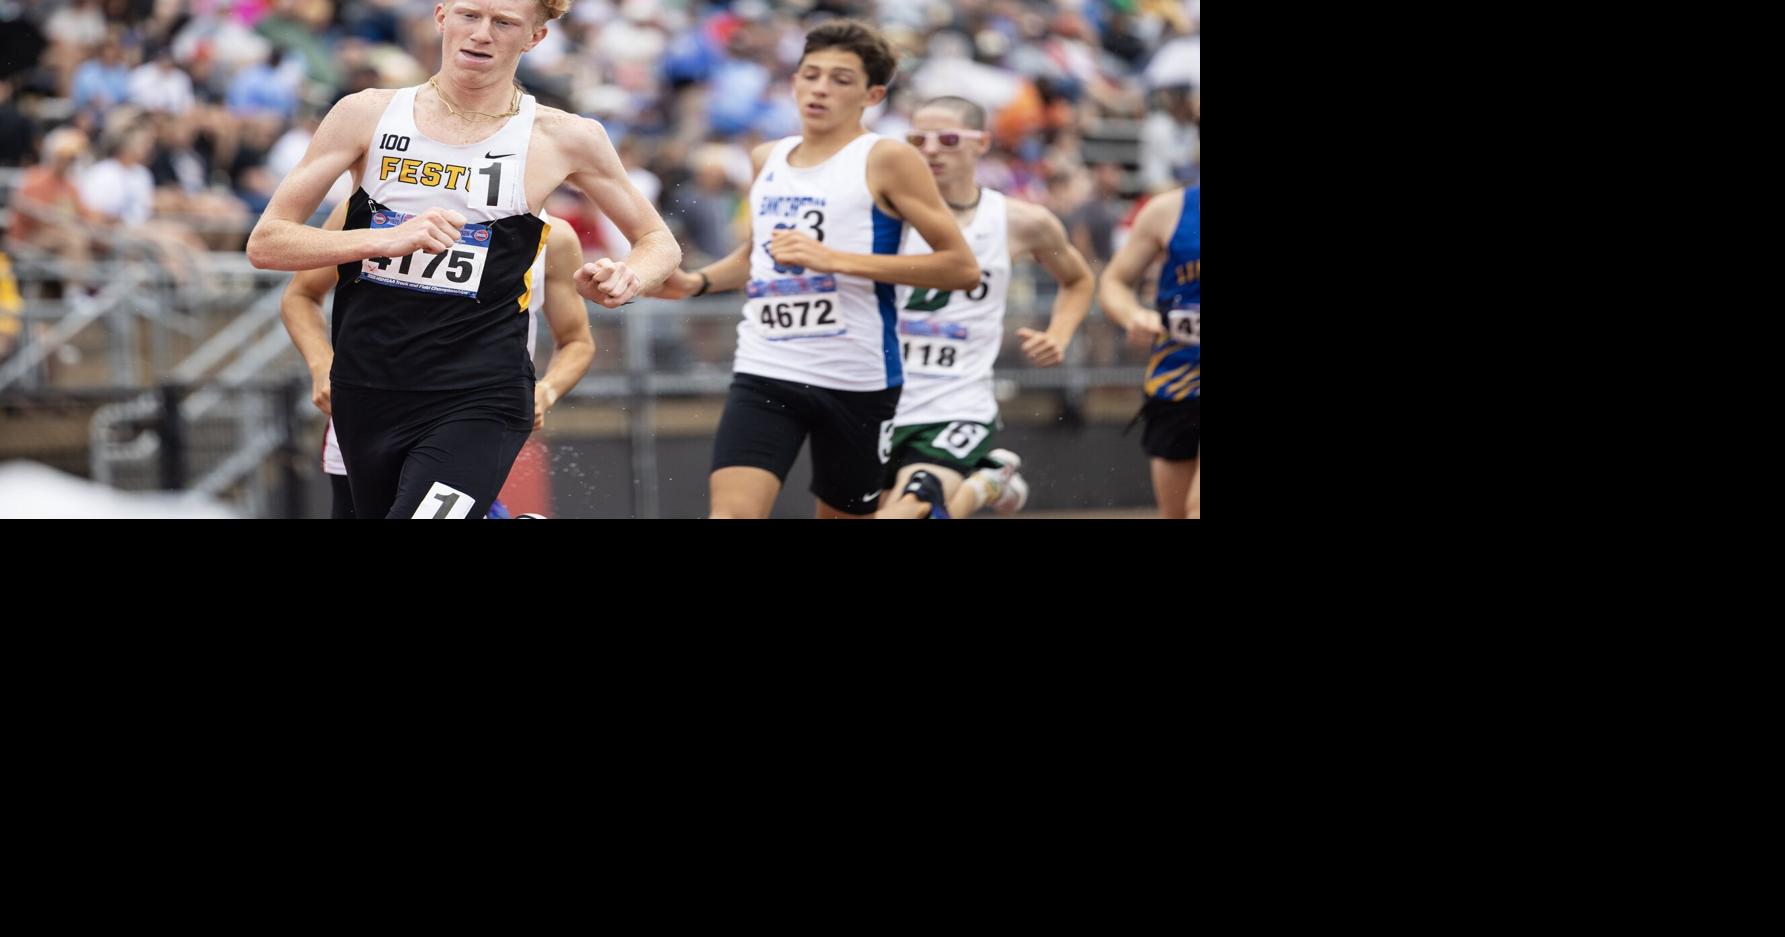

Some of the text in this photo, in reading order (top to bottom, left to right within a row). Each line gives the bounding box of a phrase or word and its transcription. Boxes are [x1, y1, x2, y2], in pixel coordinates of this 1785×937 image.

[379, 133, 411, 152] 100
[479, 162, 502, 207] 1
[803, 210, 825, 242] 3
[761, 300, 836, 328] 4672
[947, 421, 977, 449] 6
[432, 492, 460, 519] 1
